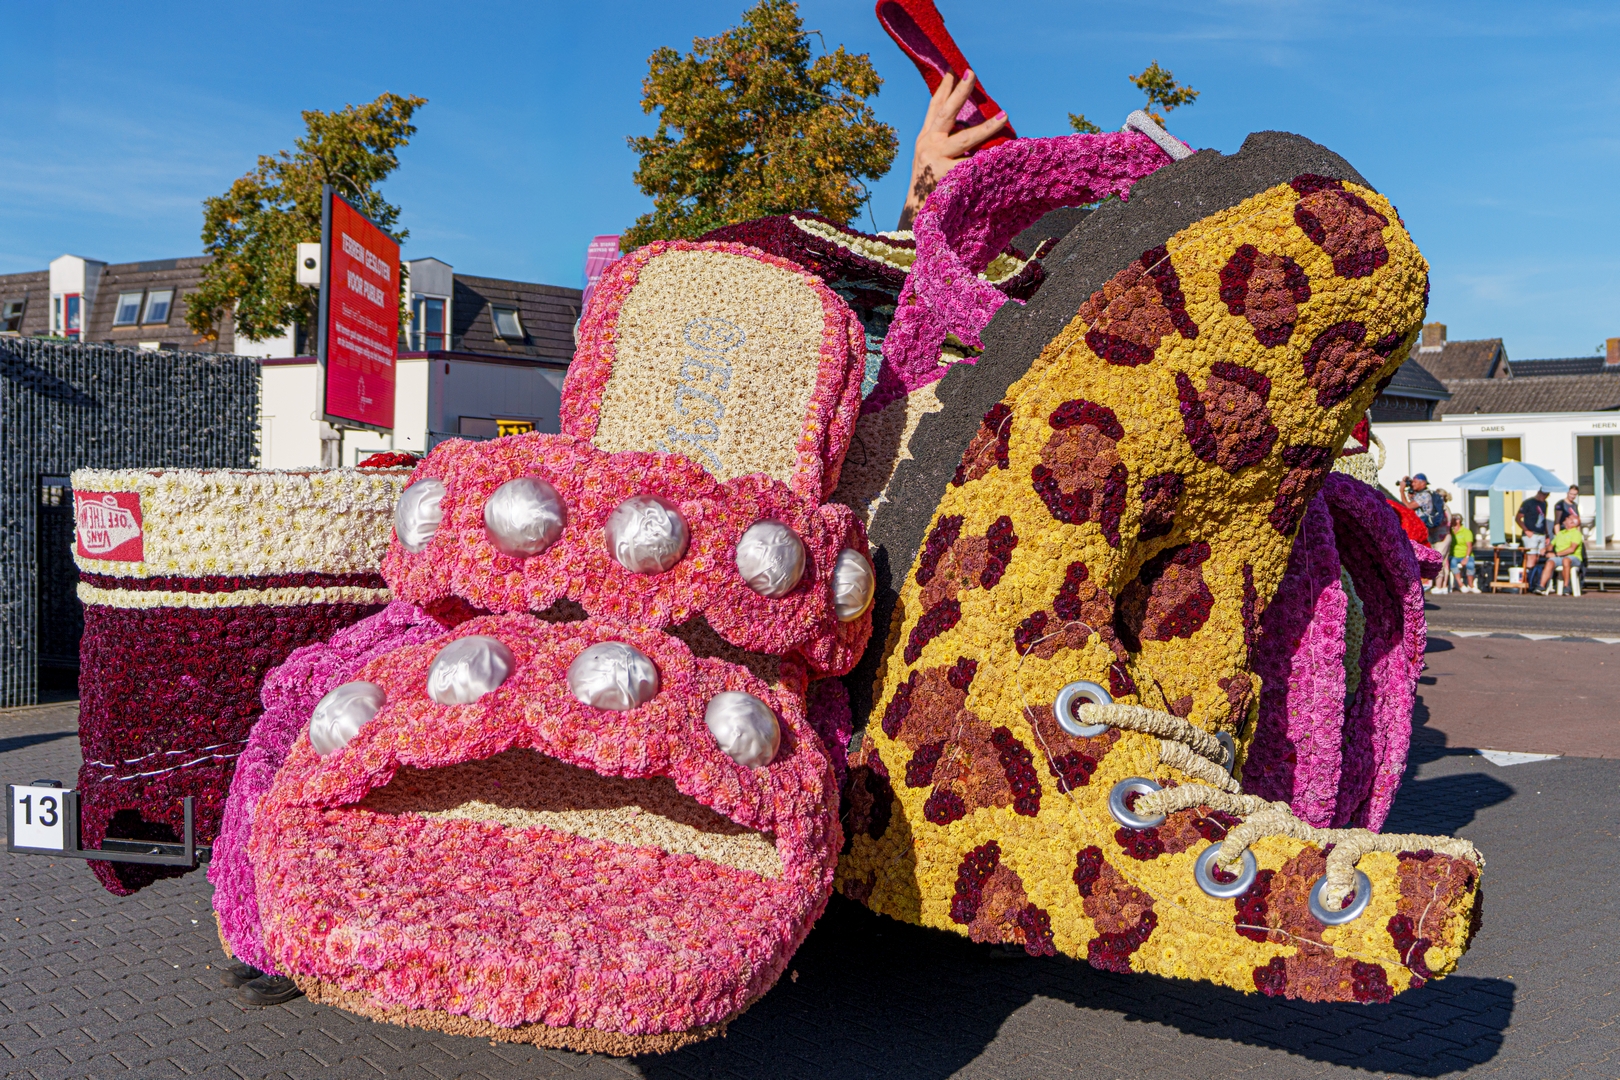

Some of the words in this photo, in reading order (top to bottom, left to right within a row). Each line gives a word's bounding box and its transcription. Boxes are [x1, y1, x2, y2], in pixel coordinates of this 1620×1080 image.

[365, 249, 391, 282] GESLOTEN
[347, 270, 364, 297] VOOR
[364, 279, 385, 308] PUBLIEK
[89, 506, 106, 529] THE
[87, 530, 111, 548] VANS
[19, 794, 59, 827] 13
